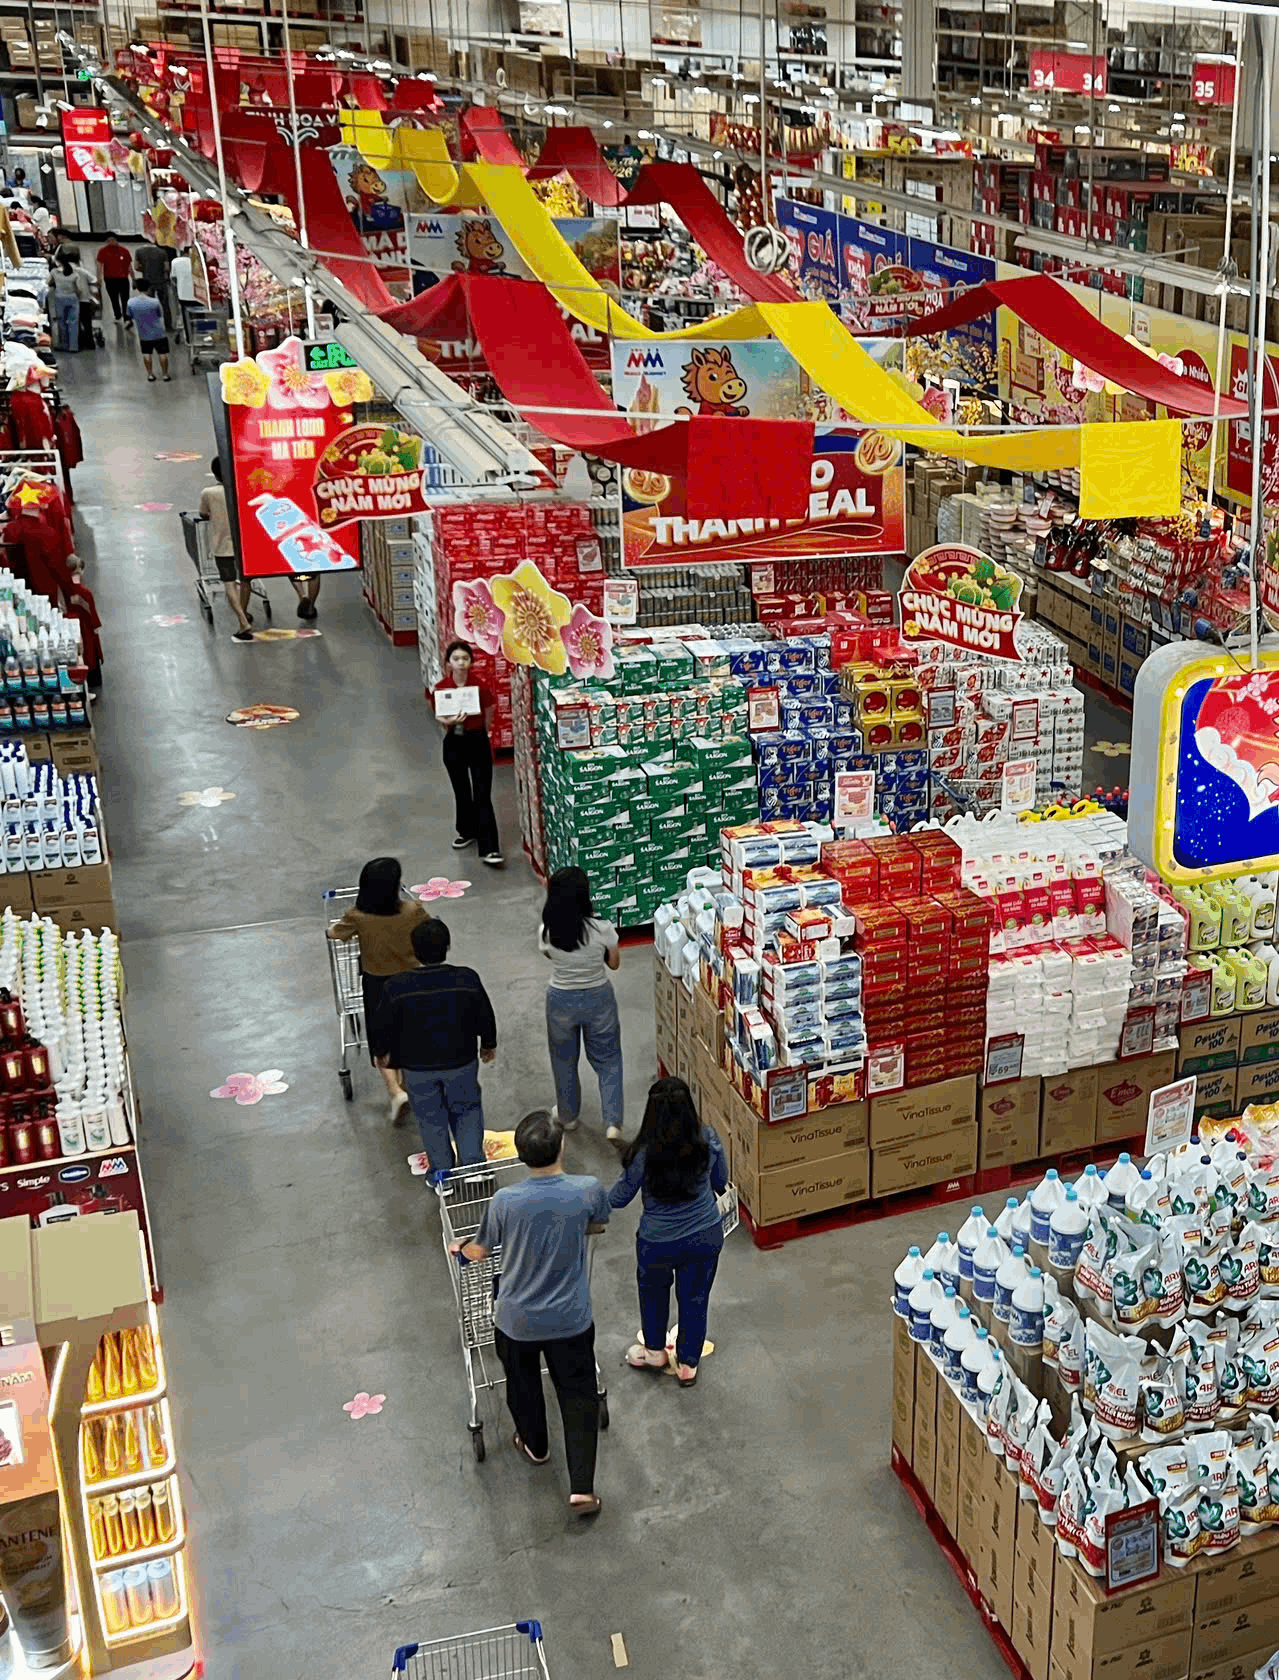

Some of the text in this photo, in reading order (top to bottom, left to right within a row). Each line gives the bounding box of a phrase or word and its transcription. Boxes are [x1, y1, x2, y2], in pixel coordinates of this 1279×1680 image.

[1033, 70, 1055, 88] 34
[1194, 81, 1215, 99] 35
[1208, 1038, 1225, 1050] 100
[1204, 1086, 1220, 1099] 100
[902, 1104, 953, 1121] VinaTissue
[790, 1126, 843, 1144] VinaTissue
[903, 1152, 953, 1170] VinaTissue
[17, 1173, 51, 1189] Simple
[791, 1177, 843, 1196] VinaTissue
[0, 1523, 57, 1545] ANTENE
